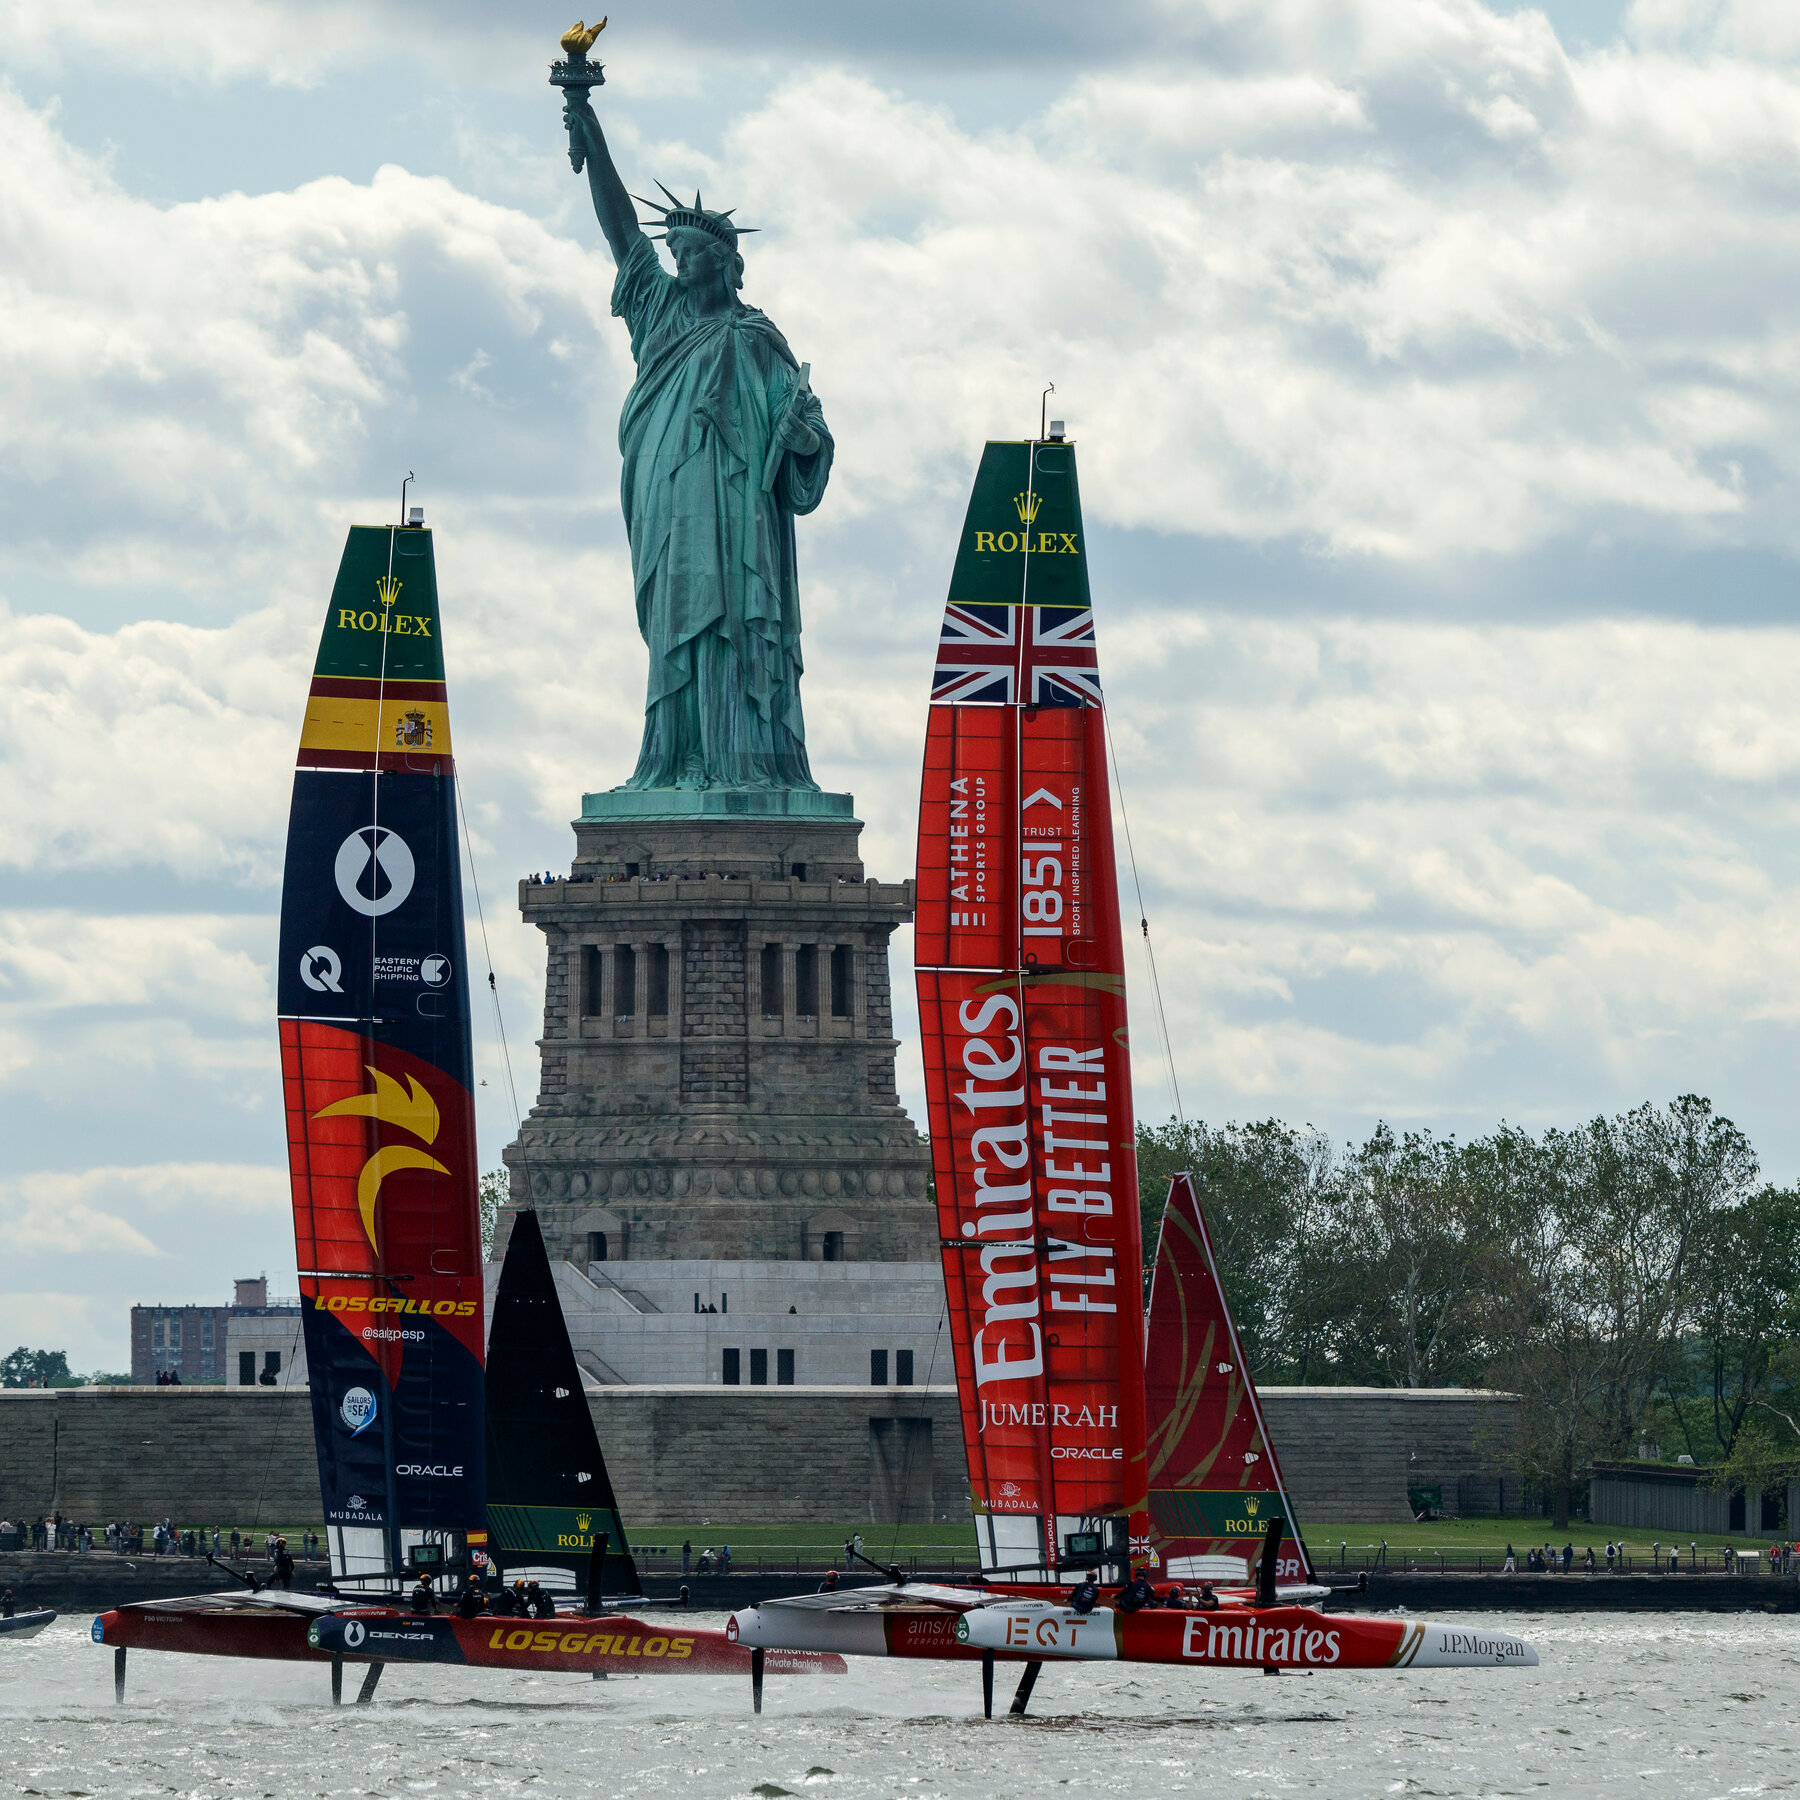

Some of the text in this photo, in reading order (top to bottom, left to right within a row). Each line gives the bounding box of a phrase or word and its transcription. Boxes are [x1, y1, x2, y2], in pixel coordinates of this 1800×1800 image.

[974, 531, 1079, 554] ROLEX
[337, 608, 433, 637] ROLEX
[950, 776, 969, 902] ATHENA
[976, 777, 986, 903] SPORTS GROUP
[1022, 827, 1063, 836] TRUST
[1071, 787, 1081, 935] SPORT INSPIRED LEARNING
[374, 957, 420, 965] EASTERN
[374, 965, 413, 973] PACIFIC
[374, 973, 420, 981] SHIPPING
[1039, 1046, 1117, 1313] FLY BETTER
[953, 993, 1044, 1388] Emirates
[314, 1295, 477, 1317] LOSGALLOS
[346, 1395, 372, 1405] SAILORS
[352, 1404, 370, 1417] SEA
[979, 1399, 1119, 1434] JUMERAH
[1050, 1447, 1123, 1460] ORACLE
[395, 1464, 464, 1477] ORACLE
[981, 1499, 1039, 1509] MUBADALA
[329, 1511, 383, 1521] MUBADALA
[1225, 1519, 1268, 1533] ROLE
[369, 1631, 434, 1641] DENZA
[1006, 1617, 1088, 1647] EQT
[1182, 1615, 1340, 1663] Emirates
[488, 1628, 695, 1658] LOSGALLOS
[1439, 1633, 1525, 1663] J.P.Morgan
[765, 1656, 823, 1672] Private Banking
